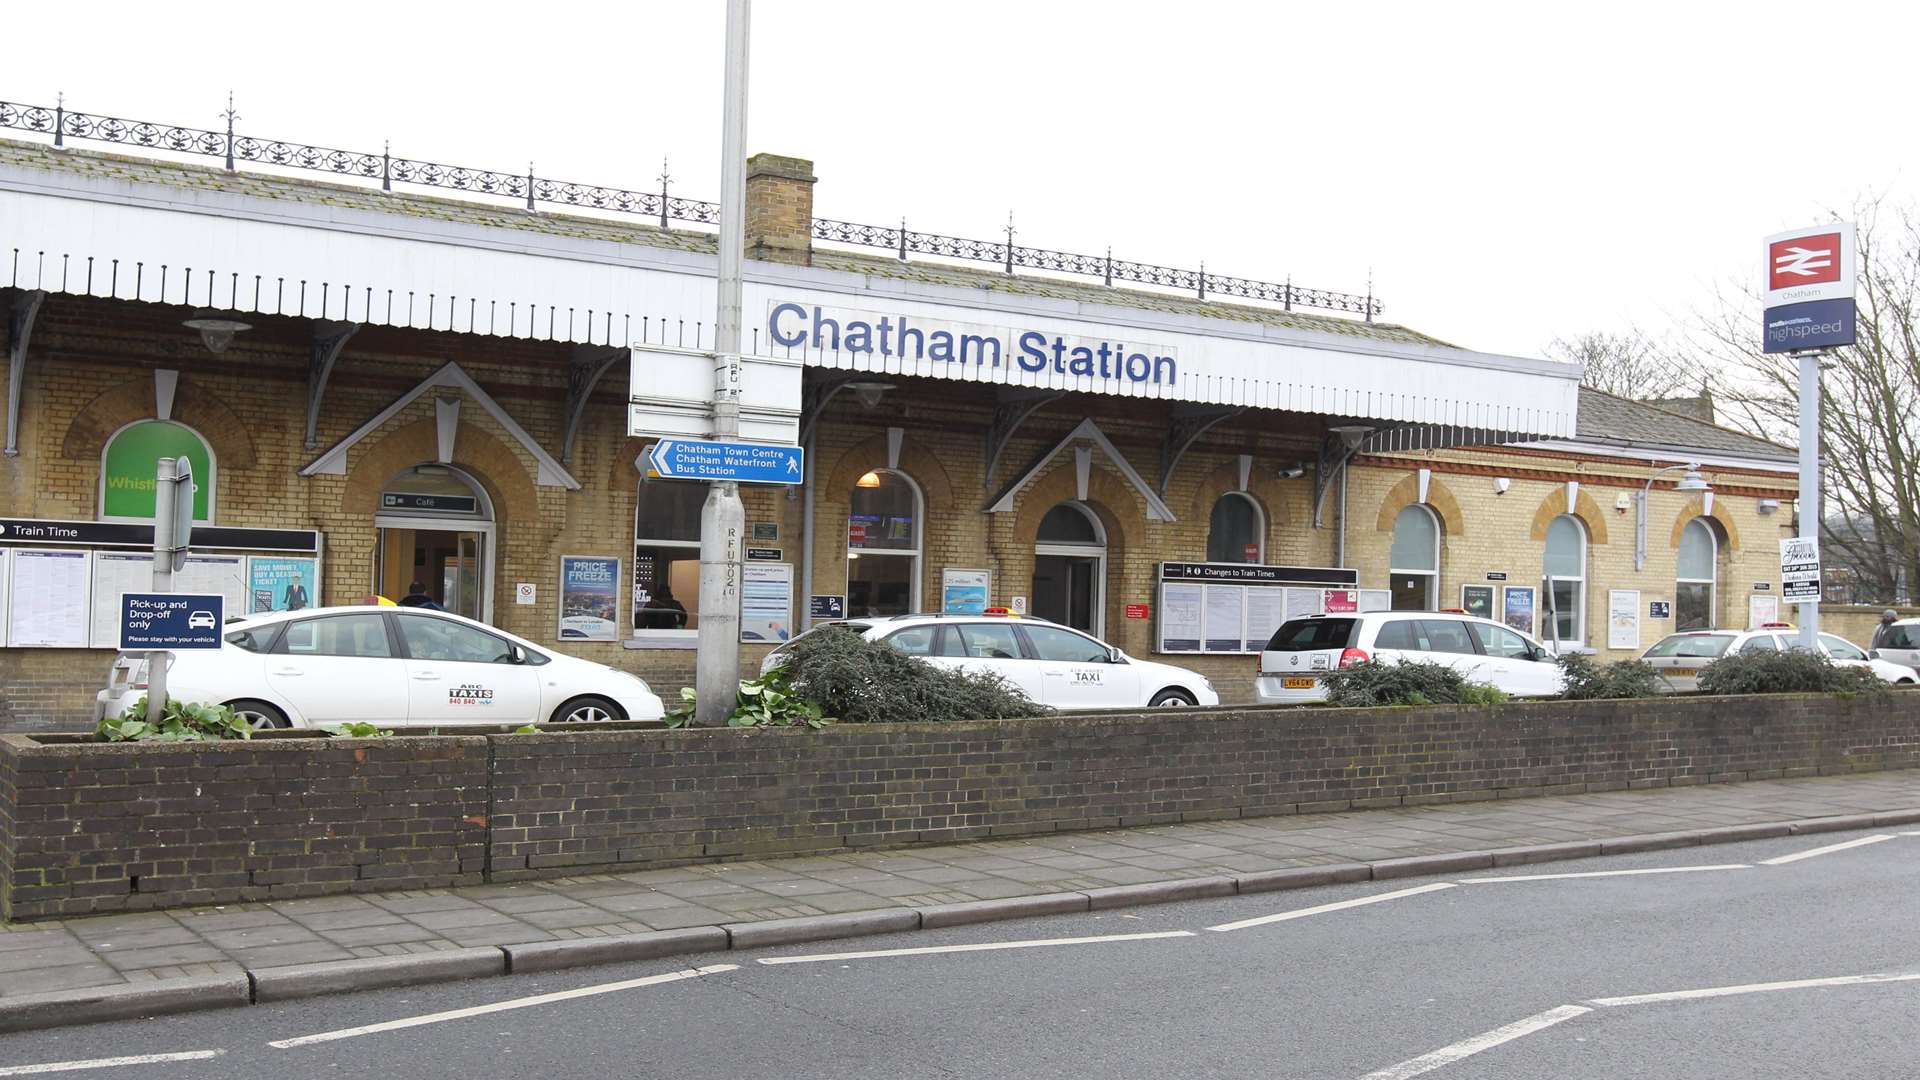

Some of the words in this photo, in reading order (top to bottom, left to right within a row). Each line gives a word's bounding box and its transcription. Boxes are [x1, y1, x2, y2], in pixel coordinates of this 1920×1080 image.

[1782, 290, 1821, 299] Chatham
[1768, 320, 1842, 342] highspeed
[768, 302, 1000, 367] Chatham
[1017, 331, 1176, 385] Station
[676, 444, 721, 455] Chatham
[724, 446, 749, 456] Town
[752, 449, 784, 458] Centre
[676, 454, 721, 465] Chatham
[724, 457, 777, 468] Waterfront
[676, 464, 695, 473] Bus
[698, 465, 736, 475] Station
[14, 525, 44, 536] Train
[47, 526, 78, 537] Time
[573, 562, 607, 572] PRICE
[1204, 567, 1232, 577] Changes
[1241, 569, 1256, 577] Train
[1257, 570, 1275, 578] Times
[568, 570, 612, 581] FREEZE
[130, 599, 167, 610] Pick-up
[169, 601, 187, 609] and
[129, 610, 171, 620] Drop-off
[129, 620, 151, 631] only
[1075, 672, 1100, 681] TAXI
[450, 690, 492, 698] TAXIS
